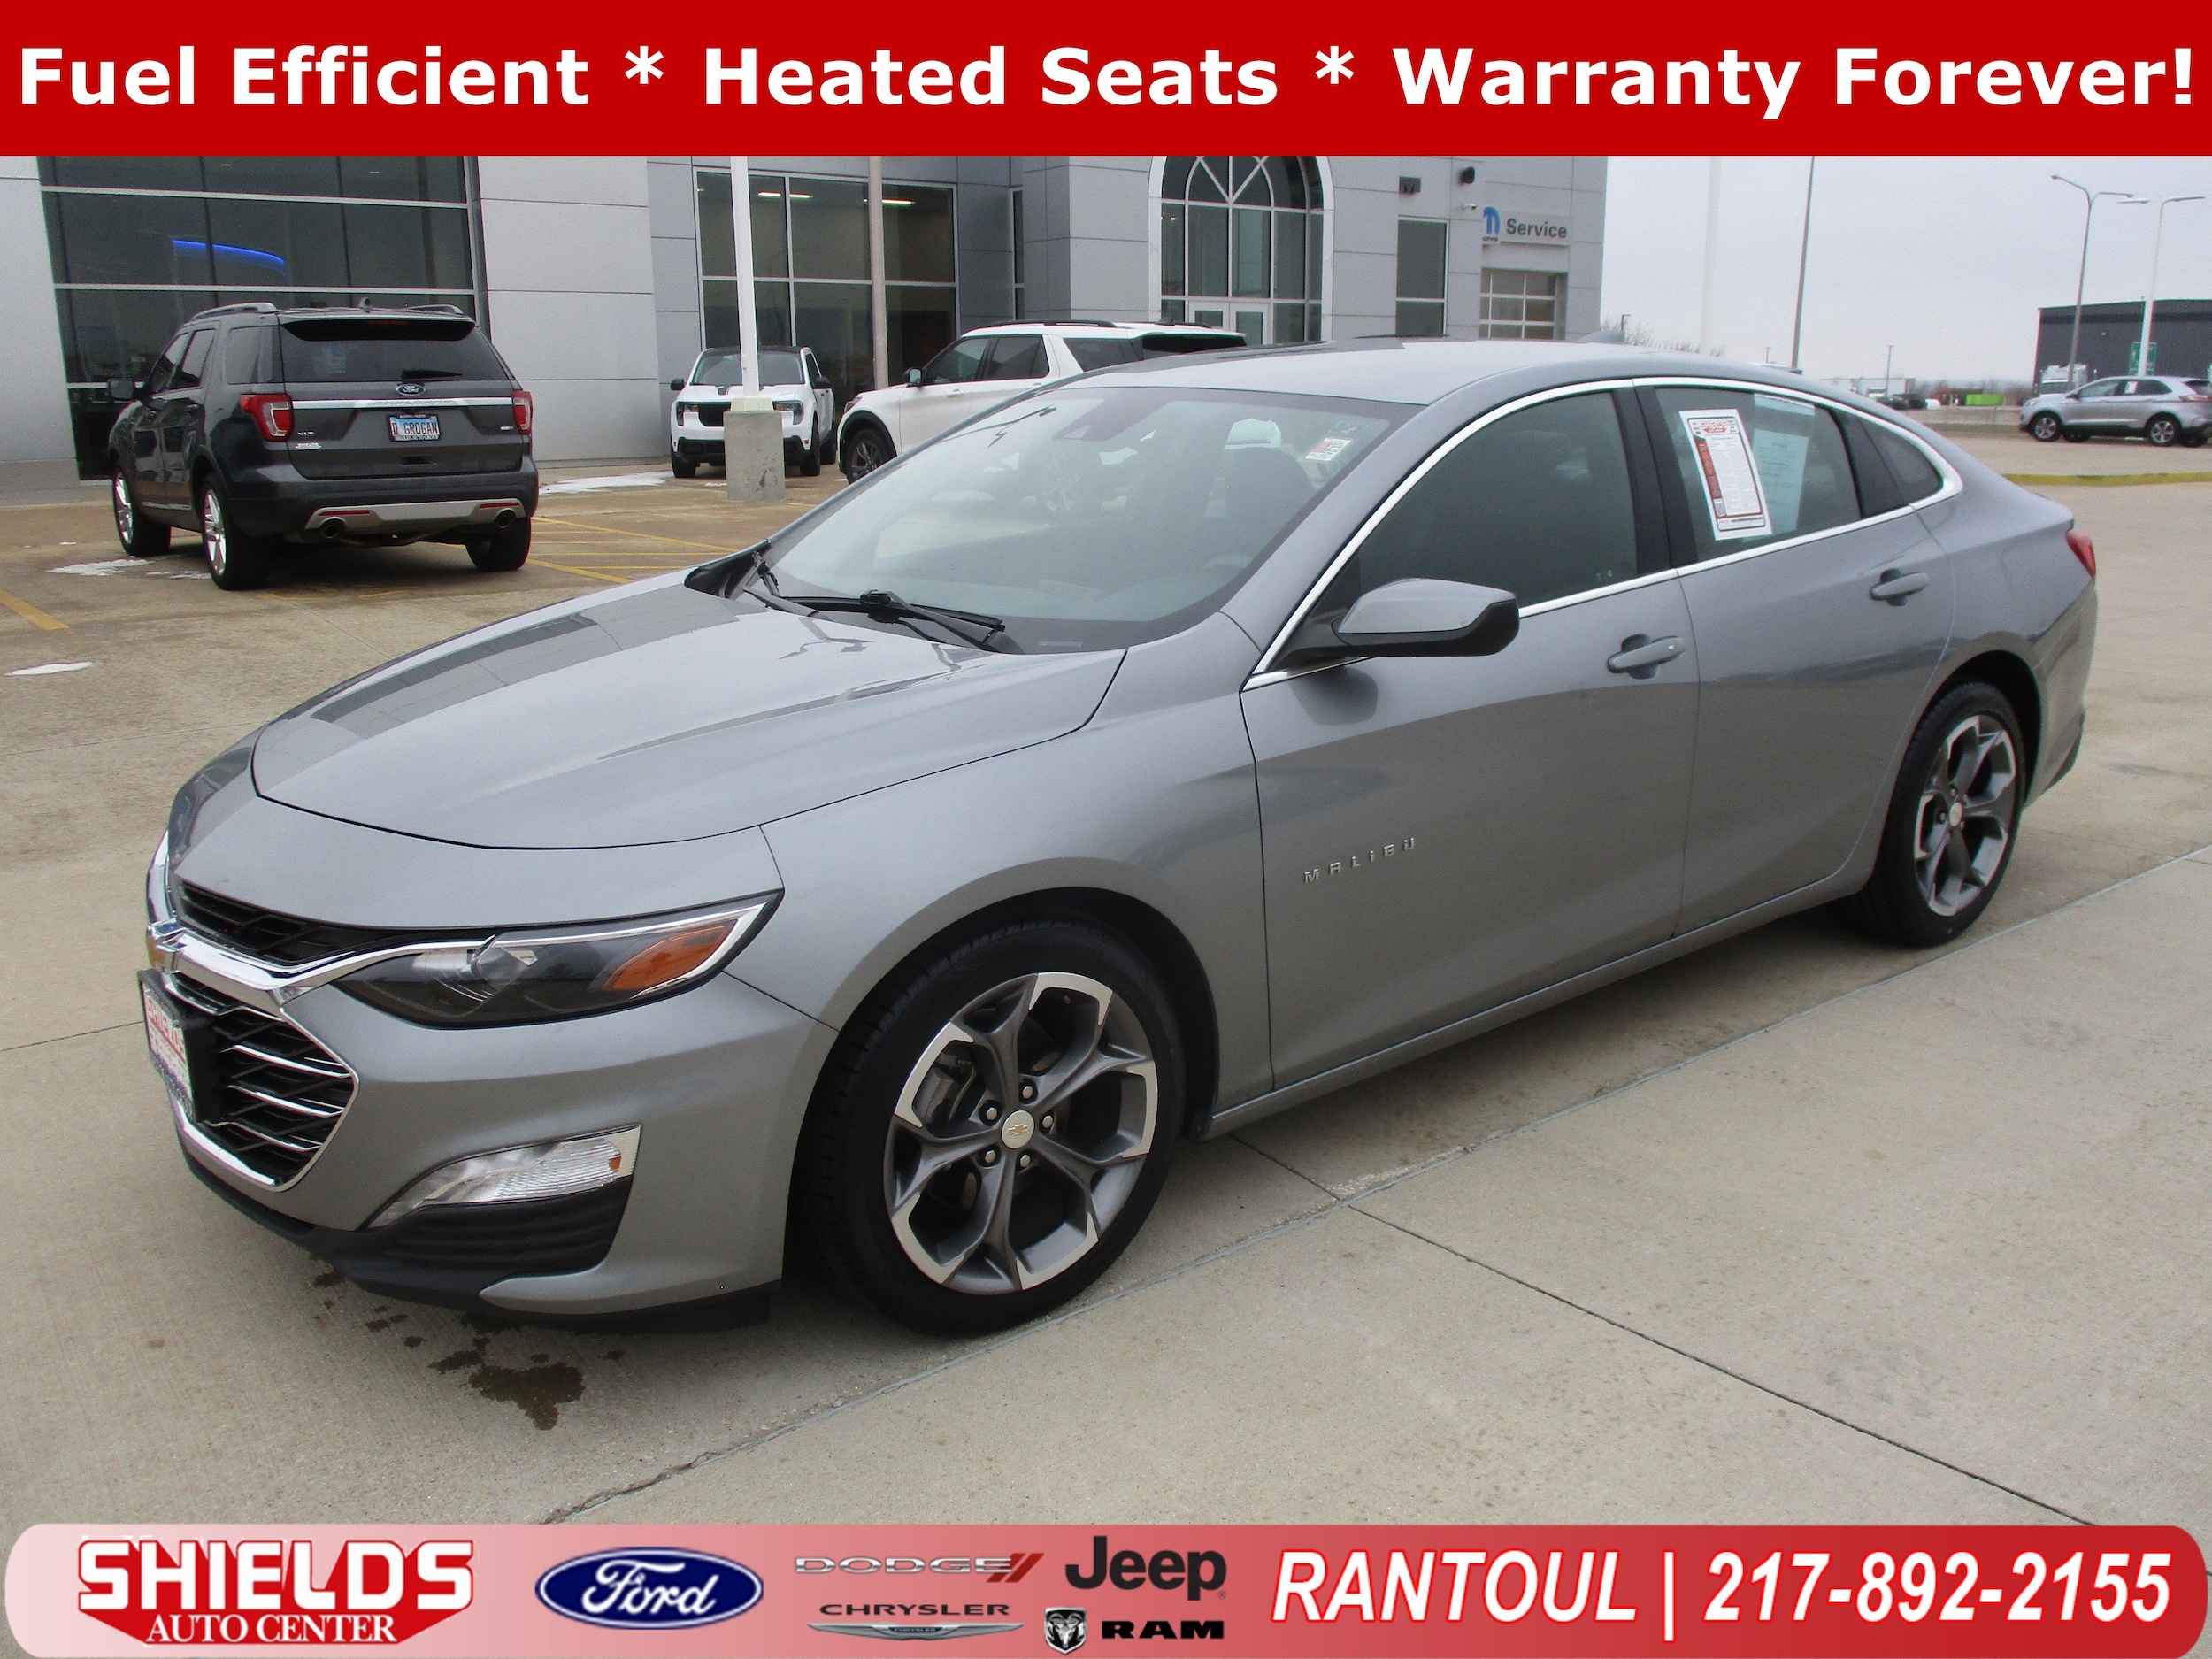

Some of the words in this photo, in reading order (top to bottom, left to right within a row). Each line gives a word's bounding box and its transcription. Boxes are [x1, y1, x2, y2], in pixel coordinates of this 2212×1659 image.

[1506, 217, 1567, 238] Service
[391, 422, 398, 434] D
[403, 421, 438, 434] GROGAN
[1304, 837, 1415, 883] MALIBU
